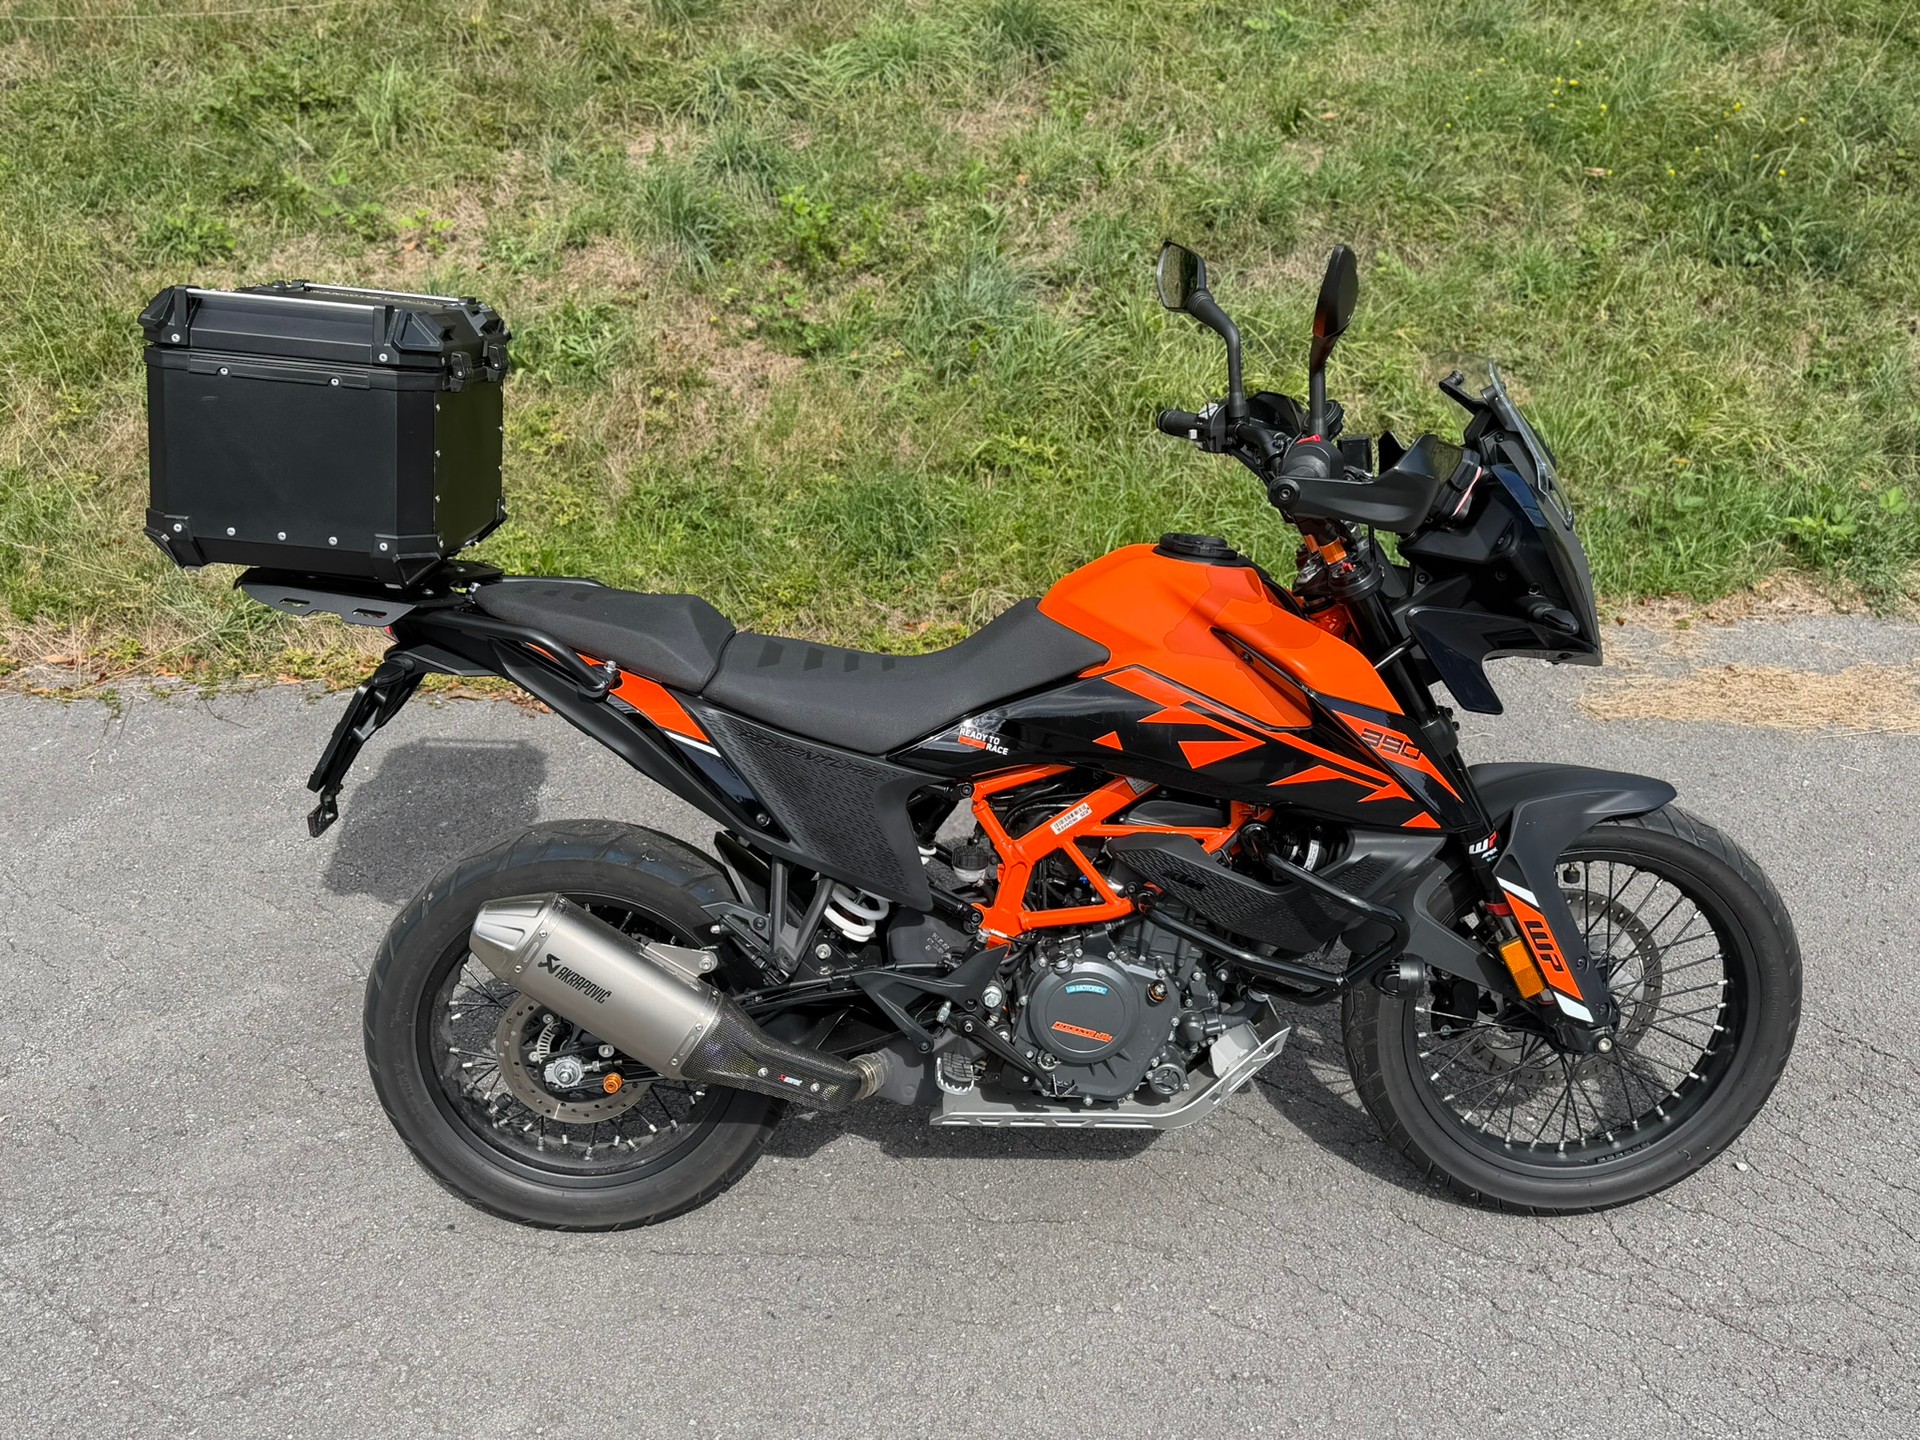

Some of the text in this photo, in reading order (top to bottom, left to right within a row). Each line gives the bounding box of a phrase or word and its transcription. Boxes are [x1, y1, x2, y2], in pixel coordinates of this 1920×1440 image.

[959, 727, 1001, 745] READY TO
[986, 743, 1009, 756] RACE
[1361, 728, 1420, 760] 390
[738, 731, 881, 778] ADVENTURE
[1468, 830, 1498, 855] WP
[1523, 920, 1565, 972] WP
